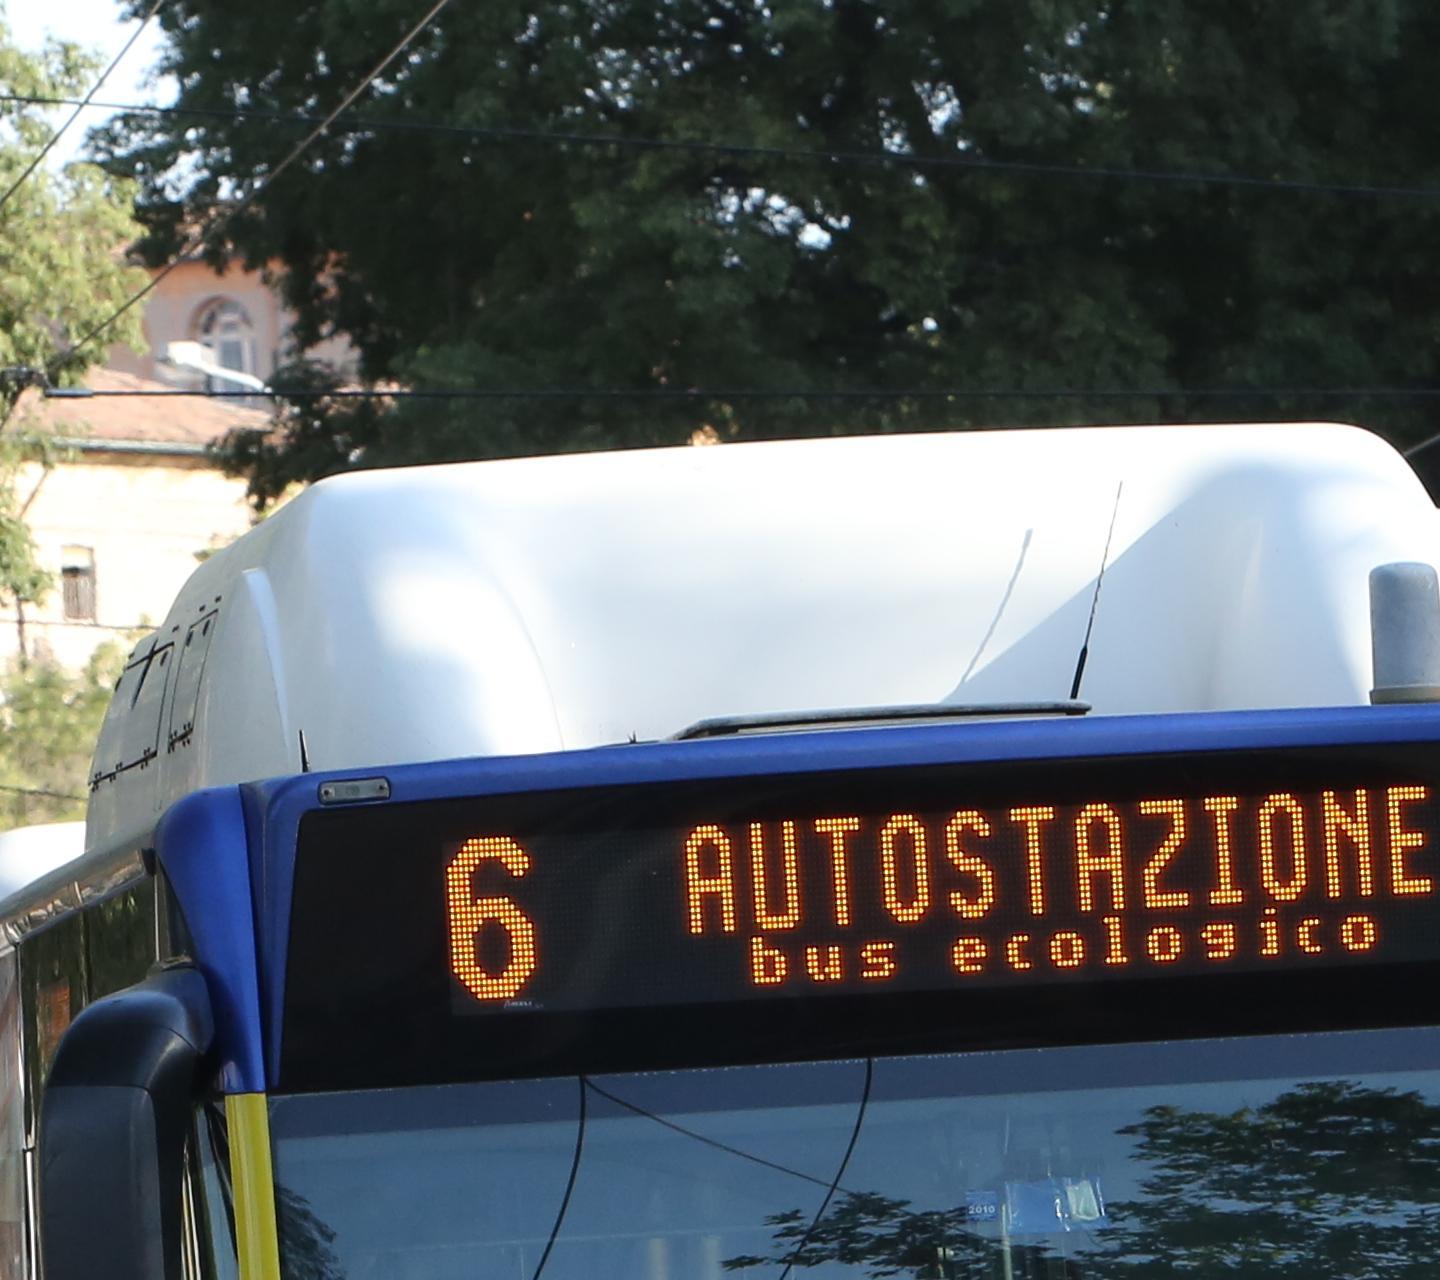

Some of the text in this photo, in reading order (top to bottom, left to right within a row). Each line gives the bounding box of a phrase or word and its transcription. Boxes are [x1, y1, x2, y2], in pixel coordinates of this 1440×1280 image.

[446, 785, 1433, 999] 6 AUTOSTAZIONE
[750, 907, 1377, 985] bus ecologico
